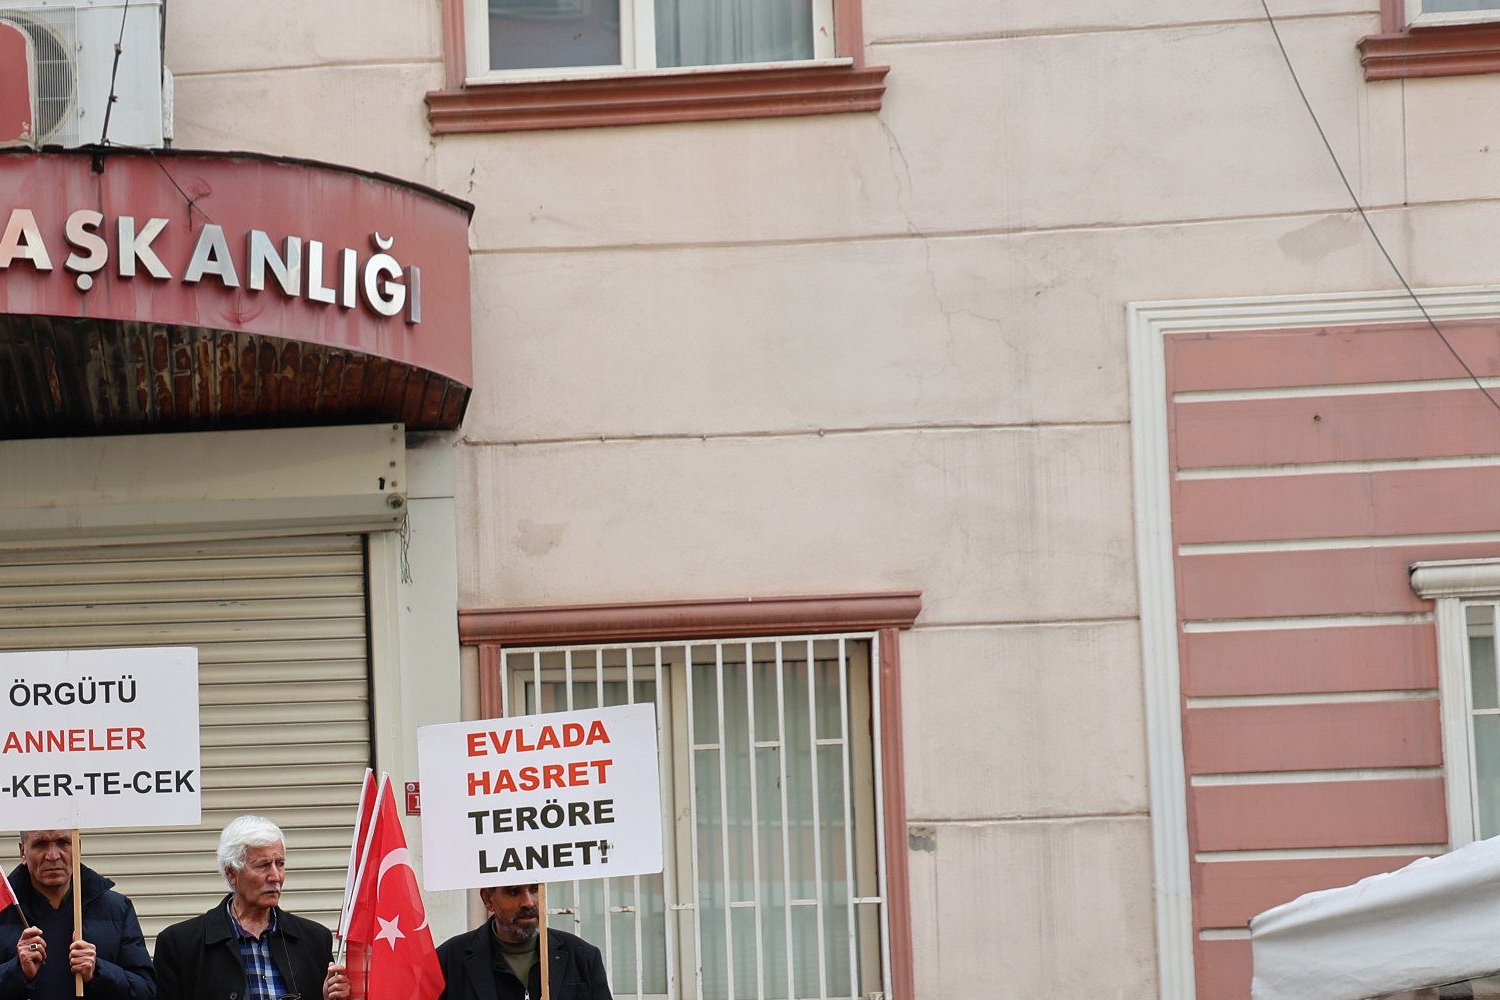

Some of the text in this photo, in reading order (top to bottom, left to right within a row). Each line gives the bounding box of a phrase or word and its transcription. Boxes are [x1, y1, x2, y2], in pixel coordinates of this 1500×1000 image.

[9, 674, 138, 707] ÖRGÜTÜ
[2, 726, 147, 754] ANNELER
[466, 720, 610, 757] EVLADA
[467, 759, 613, 796] HASRET
[468, 799, 615, 835] TERÖRE
[478, 839, 610, 874] LANET!
